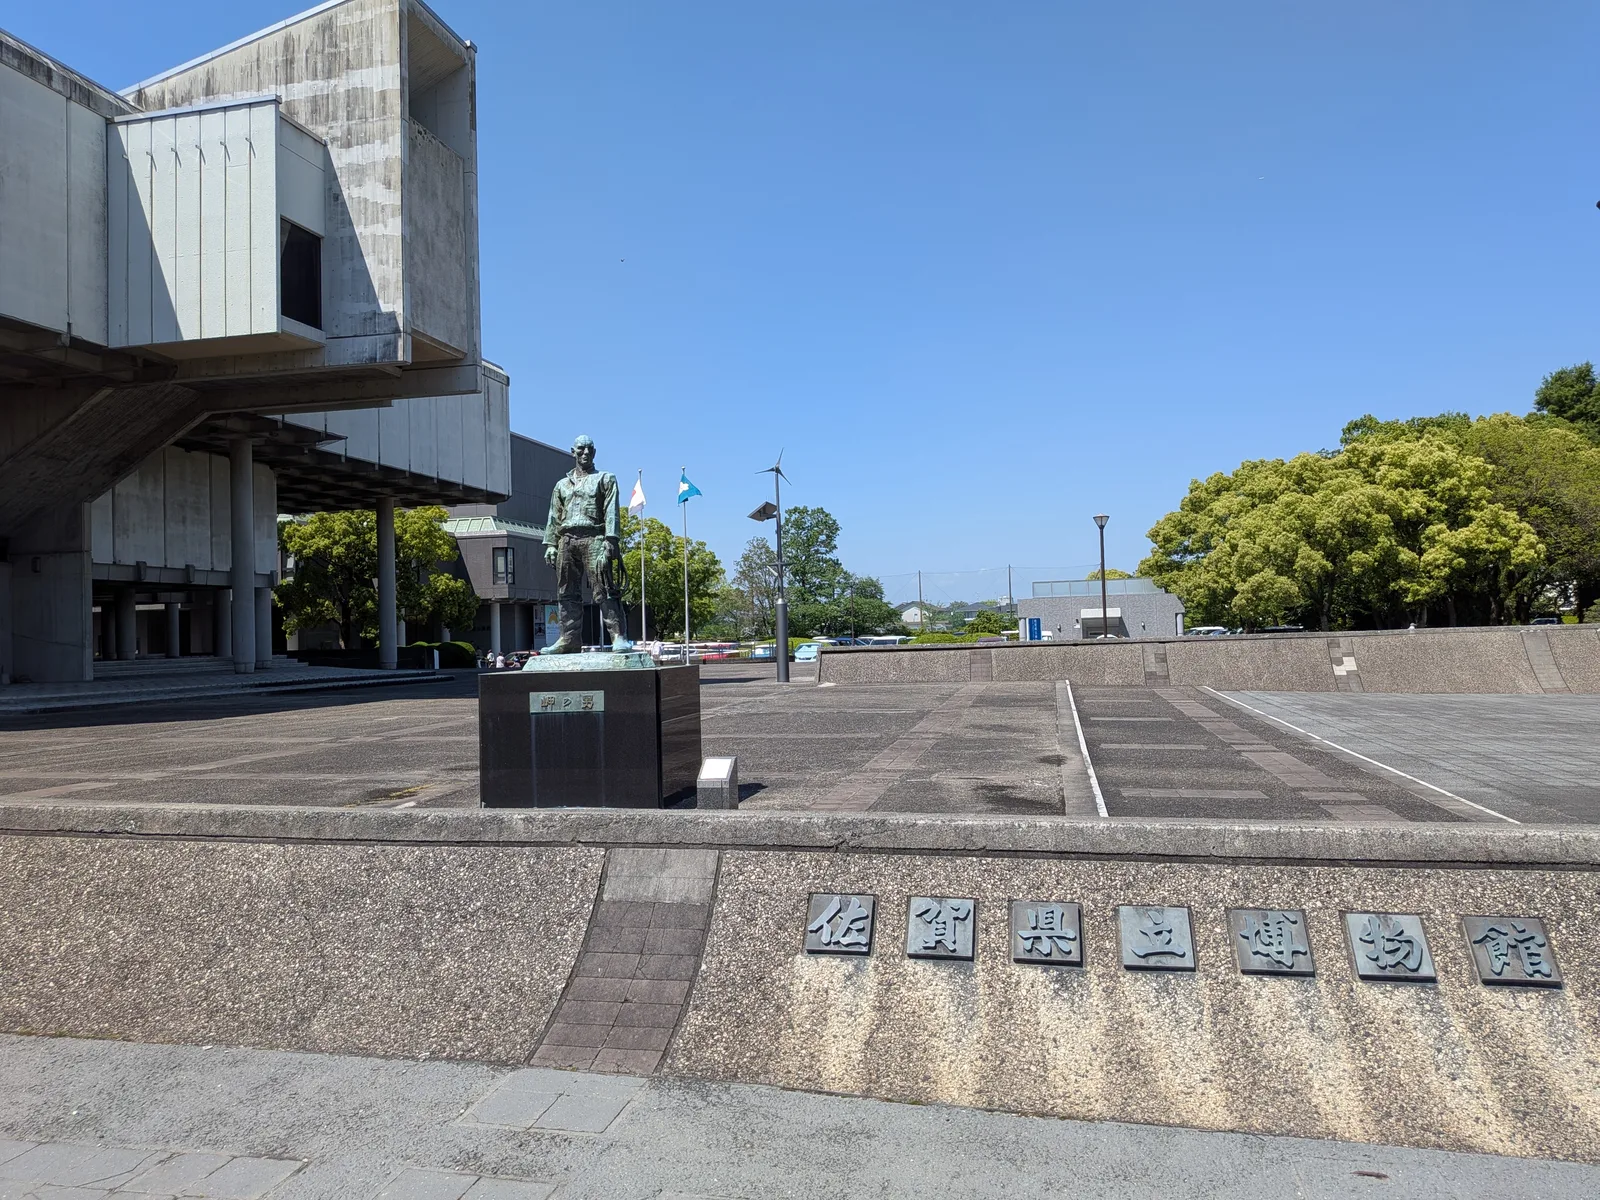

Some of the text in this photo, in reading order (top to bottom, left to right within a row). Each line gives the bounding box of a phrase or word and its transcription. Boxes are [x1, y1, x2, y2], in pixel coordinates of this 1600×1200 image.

[807, 895, 1554, 979] 佐賀県立博物館
